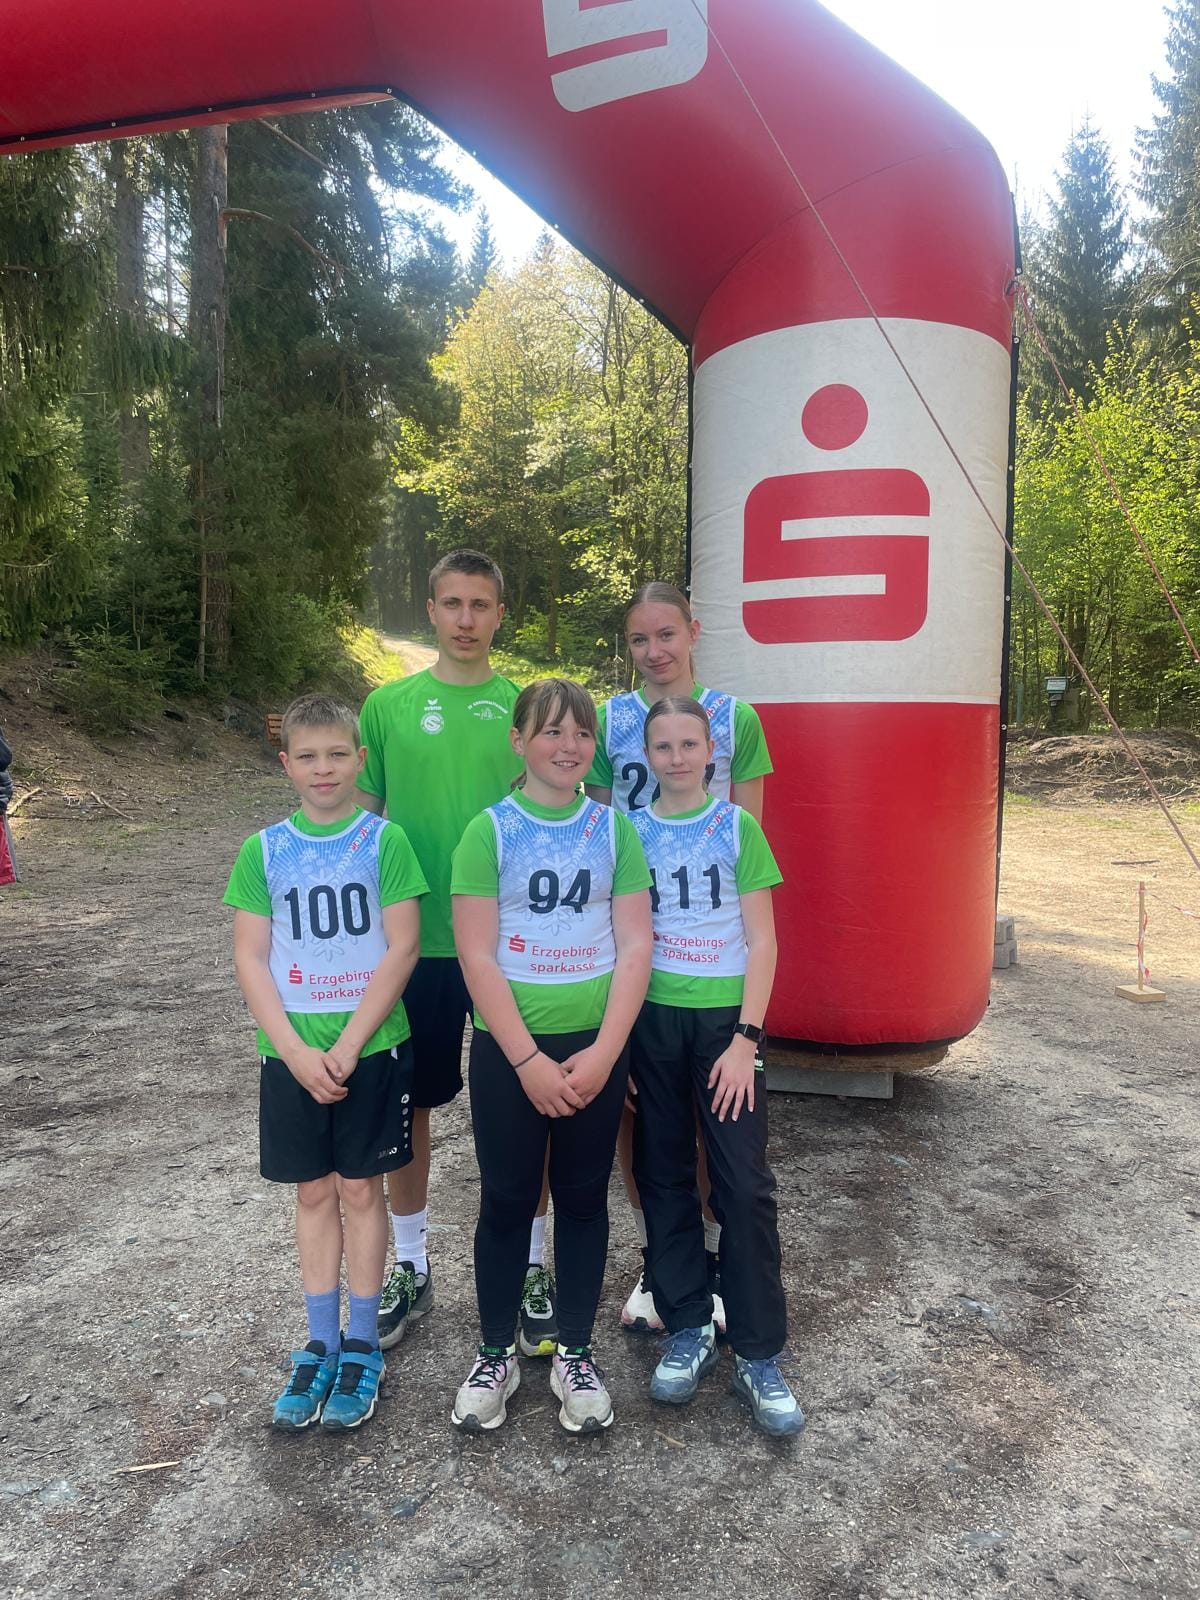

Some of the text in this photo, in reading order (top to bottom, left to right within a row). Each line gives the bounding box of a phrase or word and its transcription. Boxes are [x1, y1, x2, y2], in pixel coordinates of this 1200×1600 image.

[528, 868, 591, 914] 94
[284, 882, 371, 940] 100
[662, 935, 727, 950] Erzgebirgs-
[531, 945, 601, 960] Erzgebirgs-
[661, 948, 720, 963] sparkasse
[530, 961, 596, 974] sparkasse
[309, 969, 376, 986] Erzgebirgs
[311, 987, 367, 1001] sparkass
